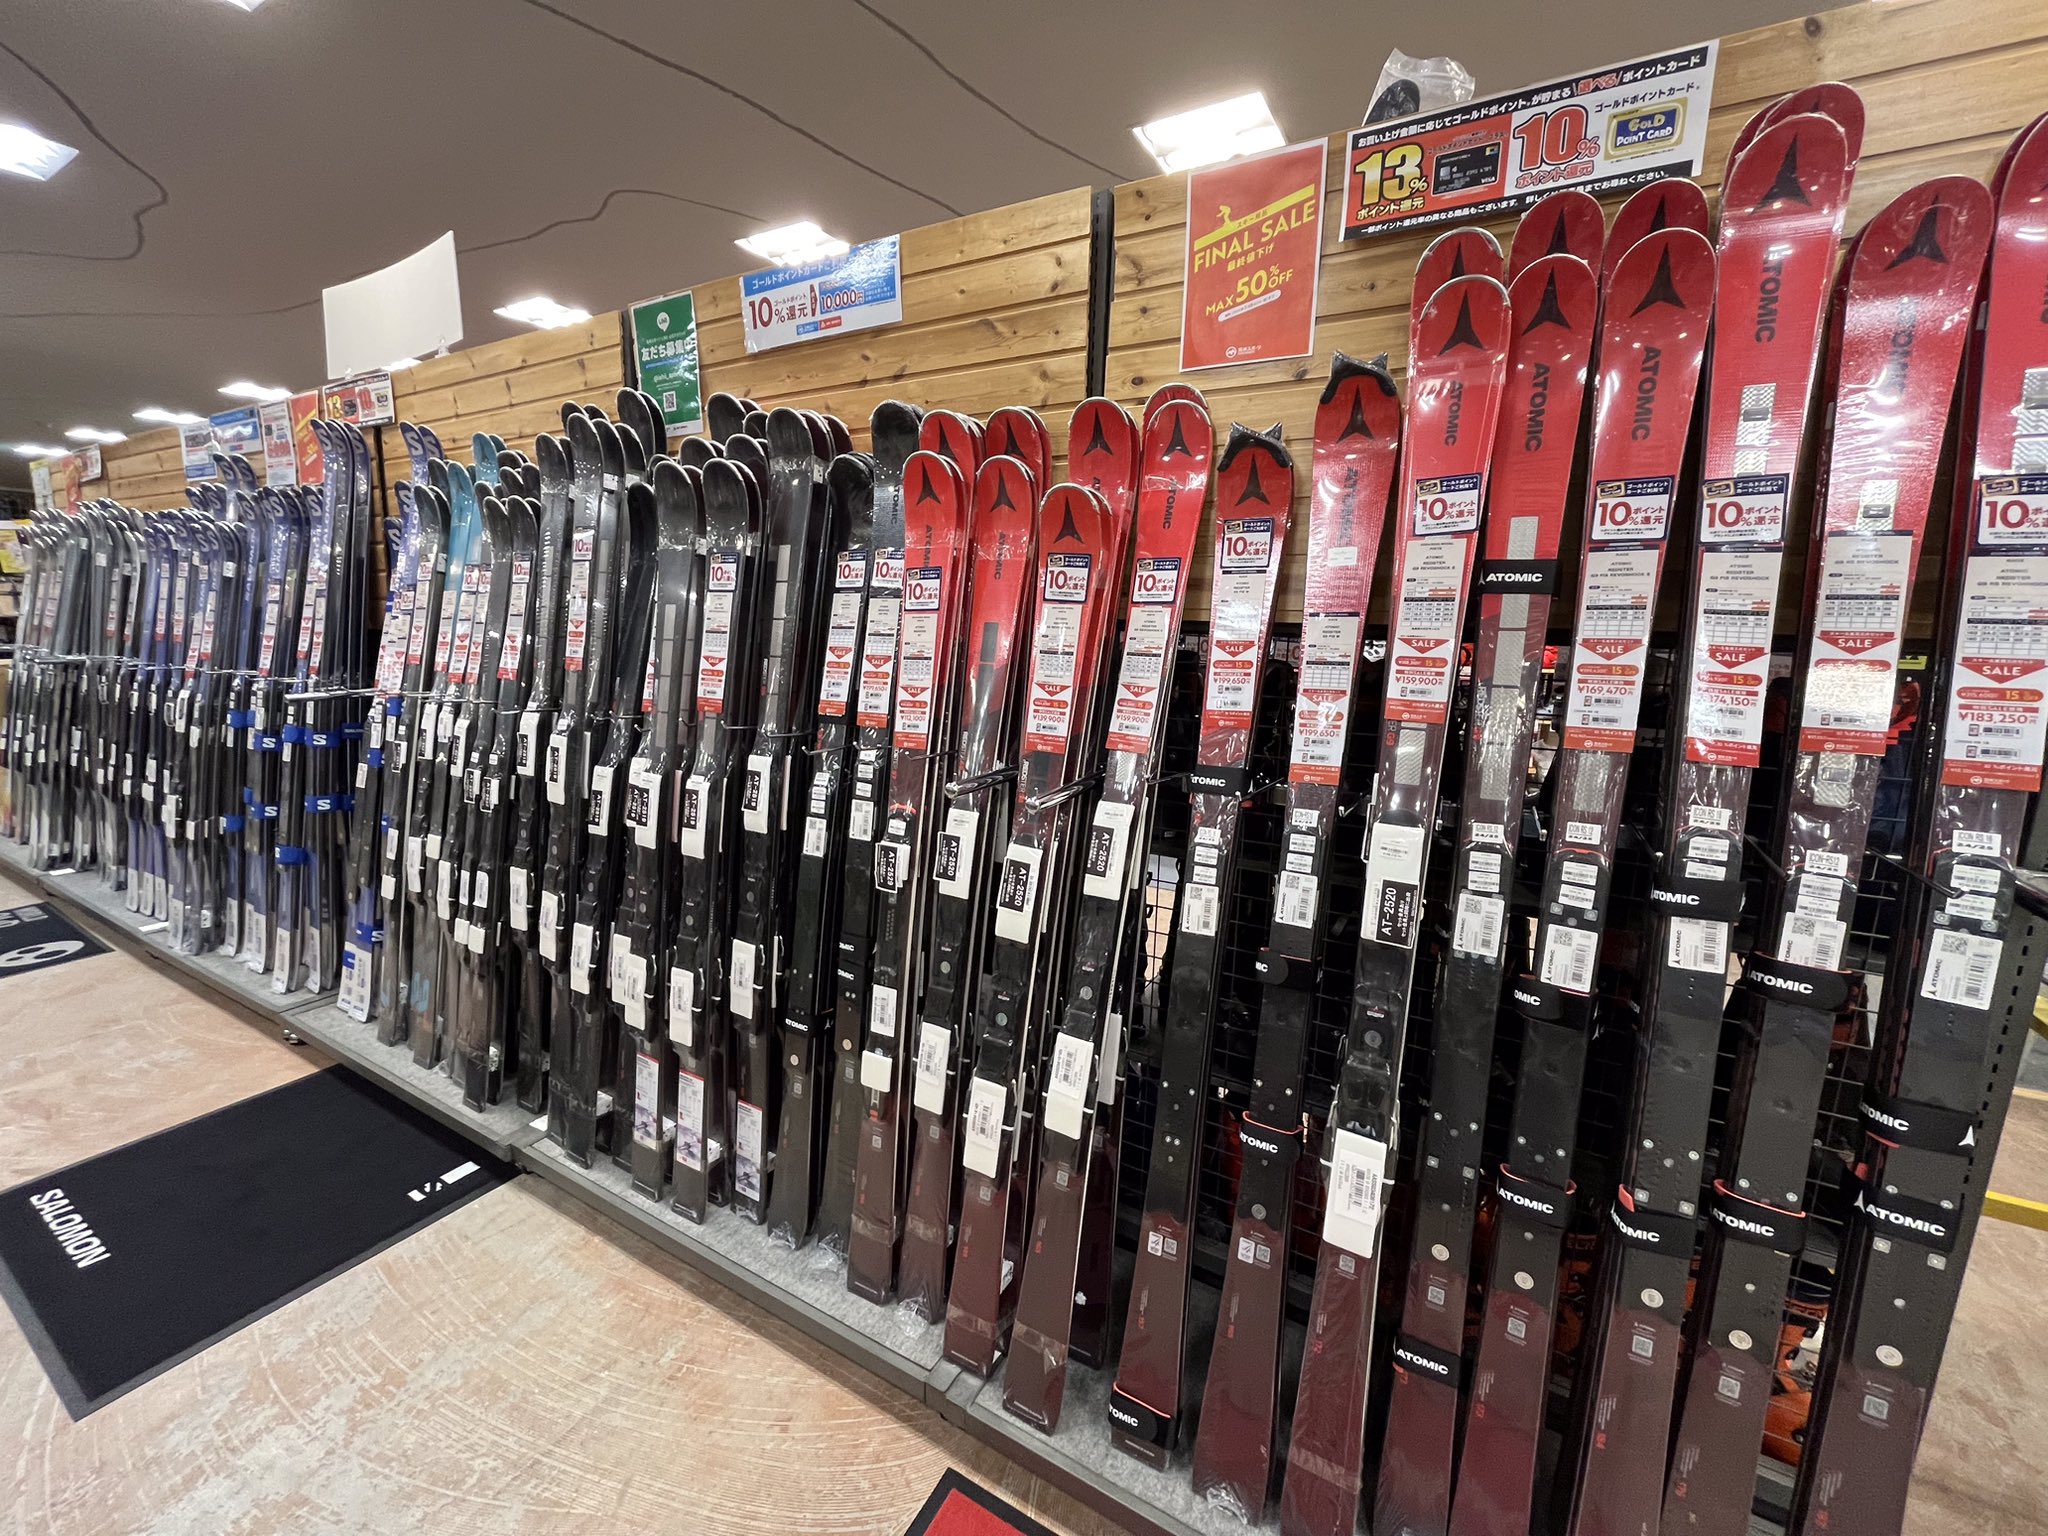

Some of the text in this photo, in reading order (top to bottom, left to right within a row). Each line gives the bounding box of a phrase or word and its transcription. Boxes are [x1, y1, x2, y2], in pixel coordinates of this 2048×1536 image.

[1616, 127, 1673, 147] POINT CARD
[1515, 160, 1595, 188] ポイント還元
[1356, 197, 1425, 221] ポイント還元
[1194, 199, 1316, 274] FINAL SALE
[1205, 294, 1235, 317] MAX
[1268, 268, 1294, 288] OFF
[1631, 344, 1661, 441] ATOMIC
[1444, 379, 1464, 446] ATOMIC
[1524, 362, 1550, 452] ATOMIC
[1419, 497, 1448, 521] 10
[1598, 501, 1632, 527] 10
[1705, 501, 1744, 529] 10
[1985, 499, 2030, 529] 10
[924, 525, 932, 567] ATOMI
[1226, 536, 1247, 556] 10
[711, 566, 723, 582] 10
[838, 563, 852, 580] 10
[875, 561, 889, 578] 10
[1048, 570, 1068, 590] 10
[1486, 572, 1543, 582] ATOMIC
[907, 582, 923, 600] 10
[1137, 574, 1156, 592] 10
[1224, 644, 1244, 652] SALE
[1411, 639, 1436, 648] SALE
[1595, 645, 1624, 654] SALE
[1838, 638, 1873, 648] SALE
[1715, 652, 1746, 662] SALE
[1395, 675, 1438, 686] ¥159,900
[1733, 675, 1744, 684] 15
[1982, 665, 2022, 675] SALE
[1129, 686, 1146, 694] SALE
[1577, 685, 1627, 695] ¥169,470
[947, 838, 958, 877] AT-2520
[1096, 832, 1108, 872] AT-2520
[1014, 866, 1028, 907] AT-2520
[1381, 887, 1397, 937] AT-2520
[1784, 939, 1793, 961] TOMIC
[1749, 970, 1814, 994] ATOMIC
[1932, 958, 1943, 988] ATOMIC
[1498, 1187, 1554, 1215] ATOMIC
[29, 1187, 111, 1269] SALOMON
[1865, 1203, 1947, 1237] ATOMIC
[1395, 1348, 1449, 1375] ATOMIC
[1109, 1405, 1139, 1427] TOMIC
